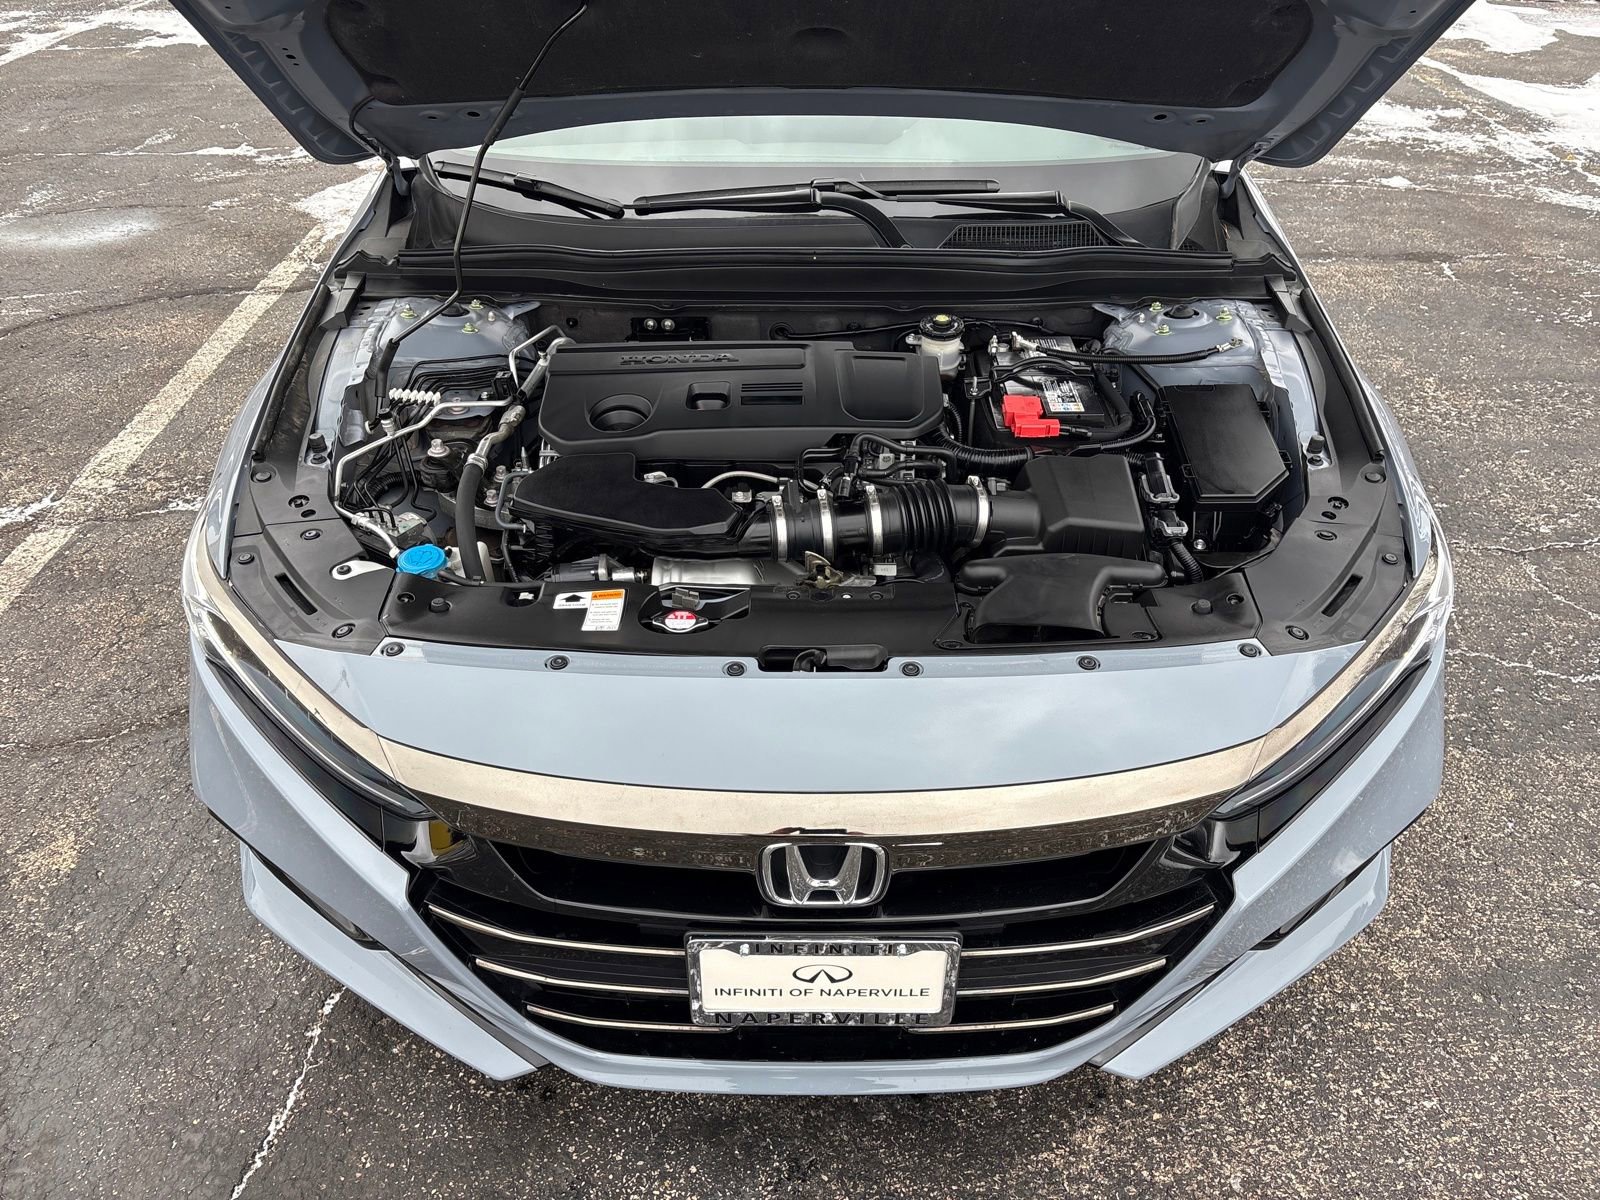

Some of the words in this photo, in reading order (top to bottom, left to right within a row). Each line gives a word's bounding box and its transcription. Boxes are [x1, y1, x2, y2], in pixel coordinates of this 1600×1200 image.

[620, 353, 739, 365] HONDA
[755, 944, 893, 954] INFINITI
[714, 988, 783, 997] INFINITI
[789, 988, 814, 997] OF
[819, 988, 930, 997] NAPERVILLE
[715, 1013, 929, 1024] NAPERVILLE
